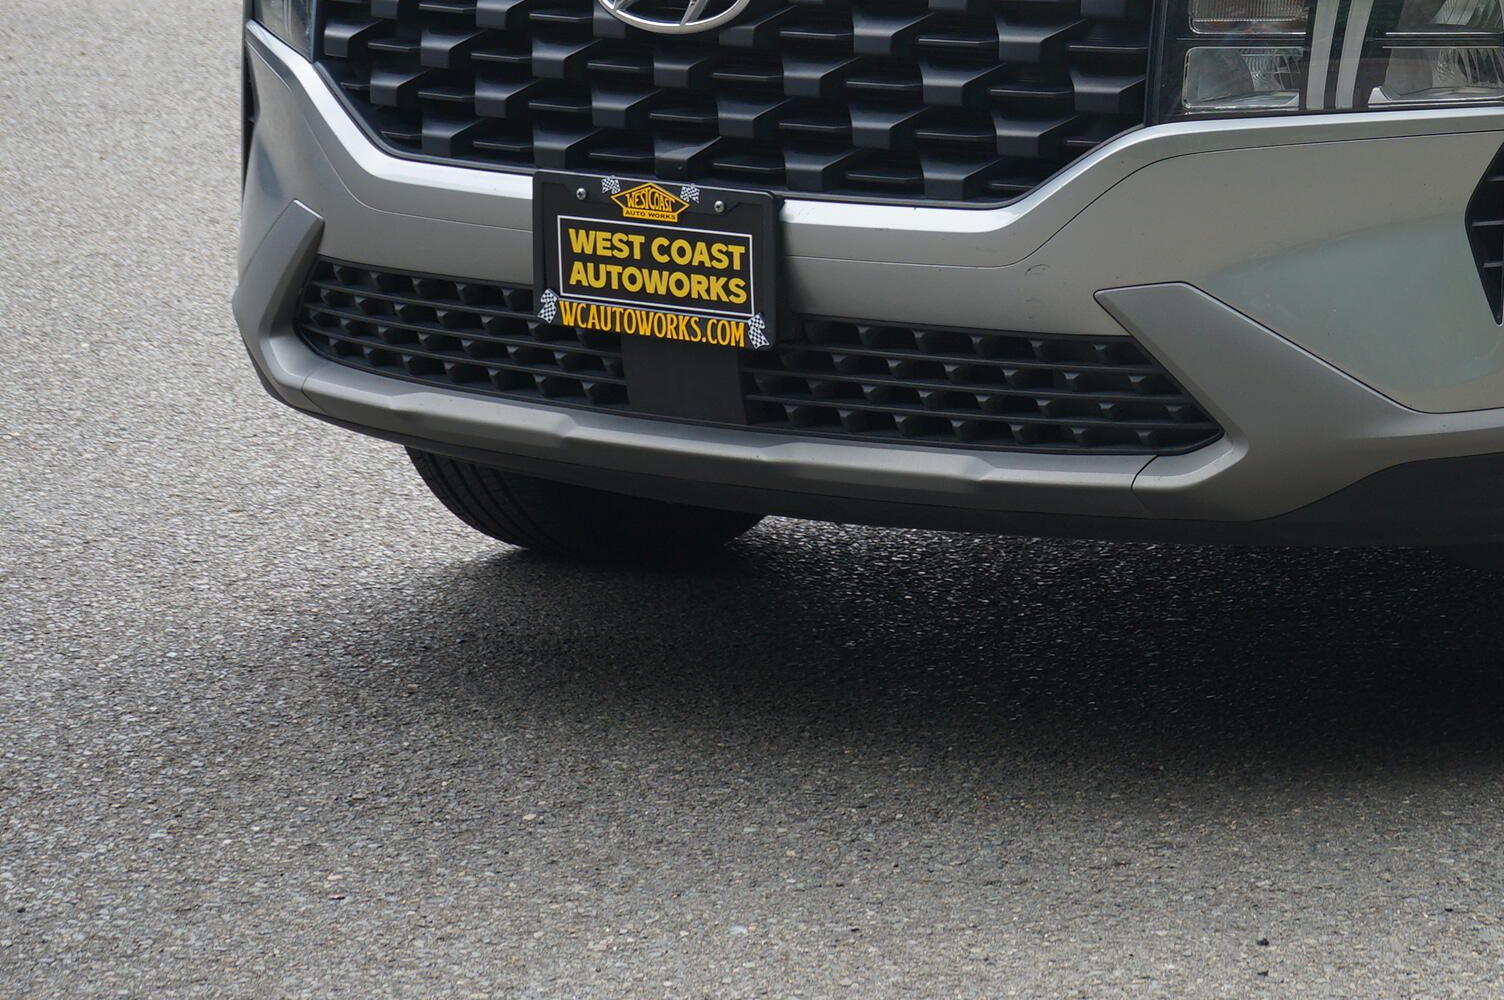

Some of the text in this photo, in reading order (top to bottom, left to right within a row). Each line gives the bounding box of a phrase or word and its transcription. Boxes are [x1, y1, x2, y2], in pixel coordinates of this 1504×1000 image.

[648, 212, 676, 220] WORKS
[568, 228, 745, 271] WEST COAST
[569, 261, 748, 304] AUTOWORKS
[559, 300, 745, 347] WCAUTOWORKS.COM
